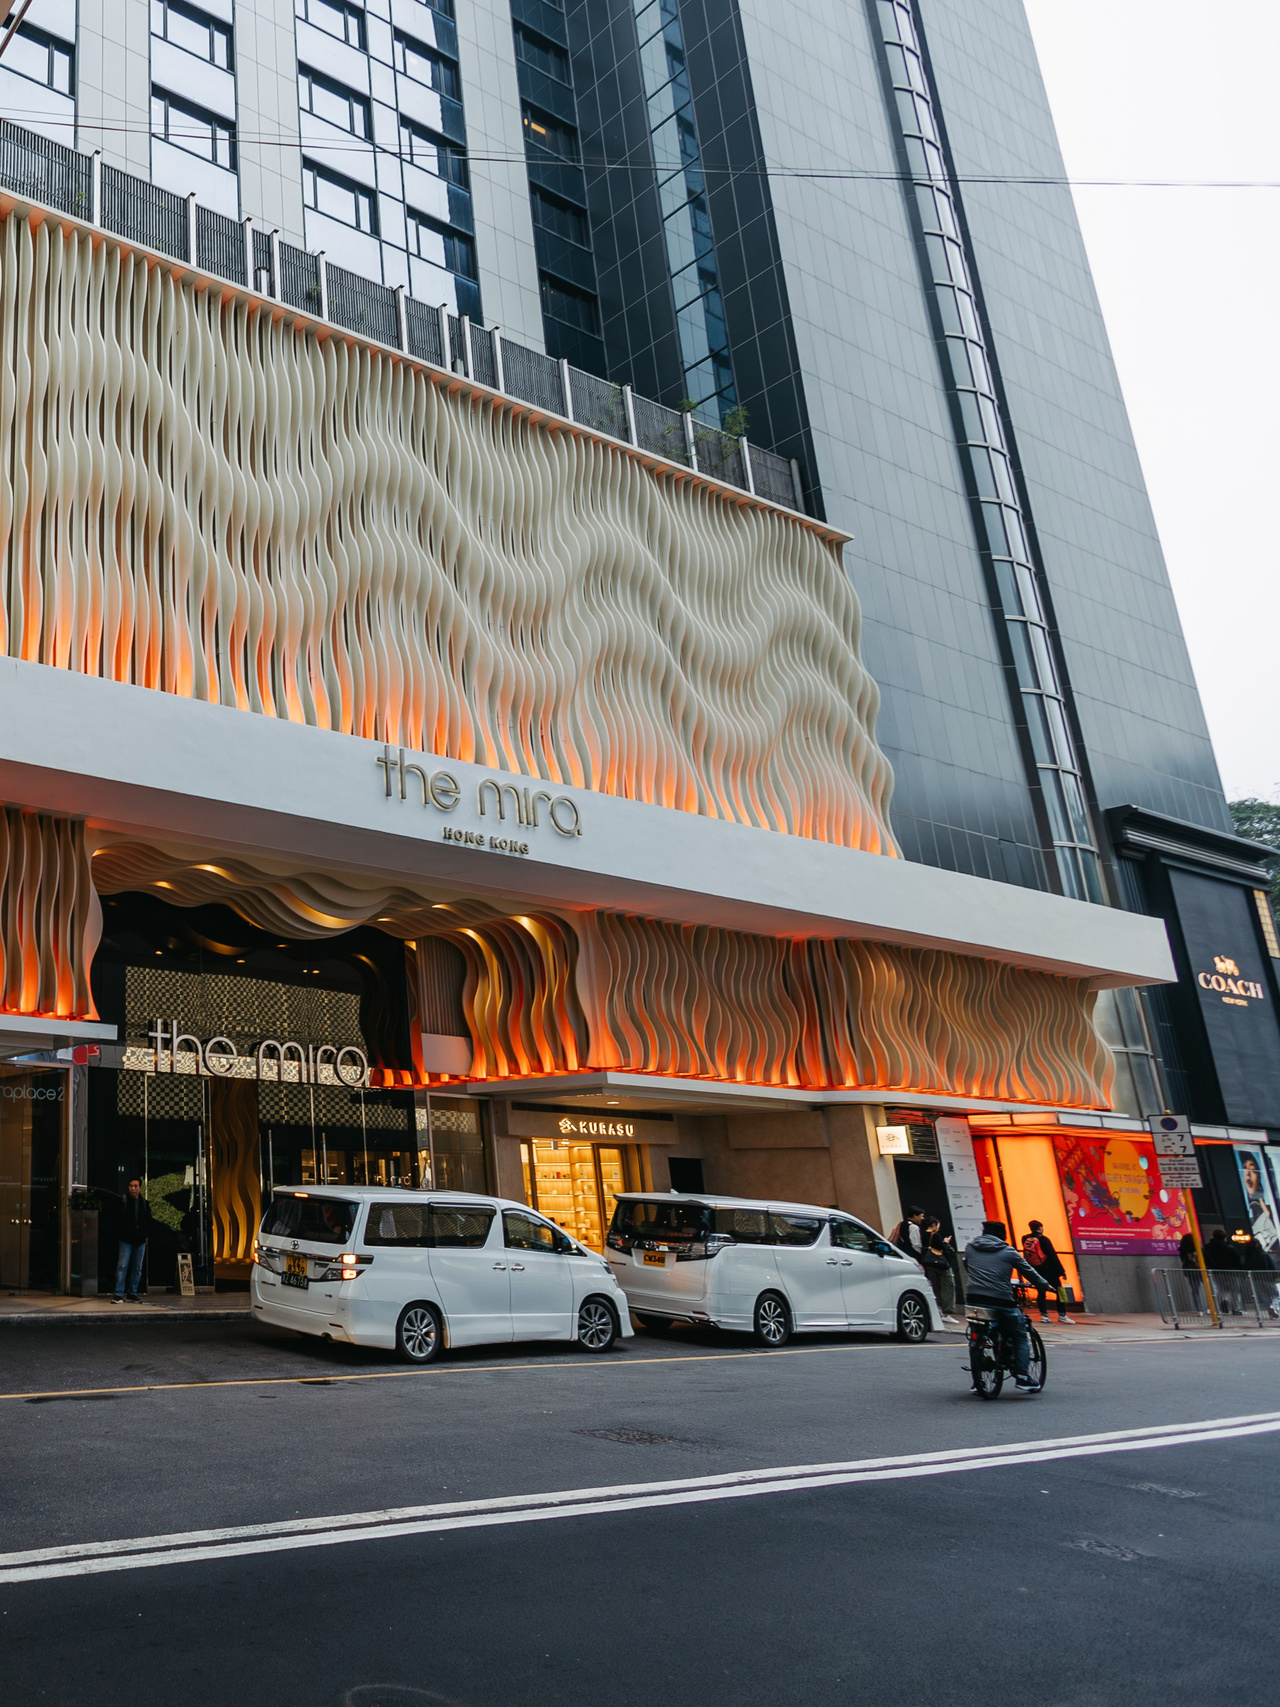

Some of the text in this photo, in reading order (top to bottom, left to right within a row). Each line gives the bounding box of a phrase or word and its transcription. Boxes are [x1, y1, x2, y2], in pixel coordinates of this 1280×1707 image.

[376, 745, 583, 836] the mira
[443, 826, 529, 855] HONG KONG
[1198, 972, 1264, 999] COACH
[148, 1018, 369, 1087] the mira
[58, 1086, 65, 1101] 2
[579, 1121, 634, 1137] KURASU
